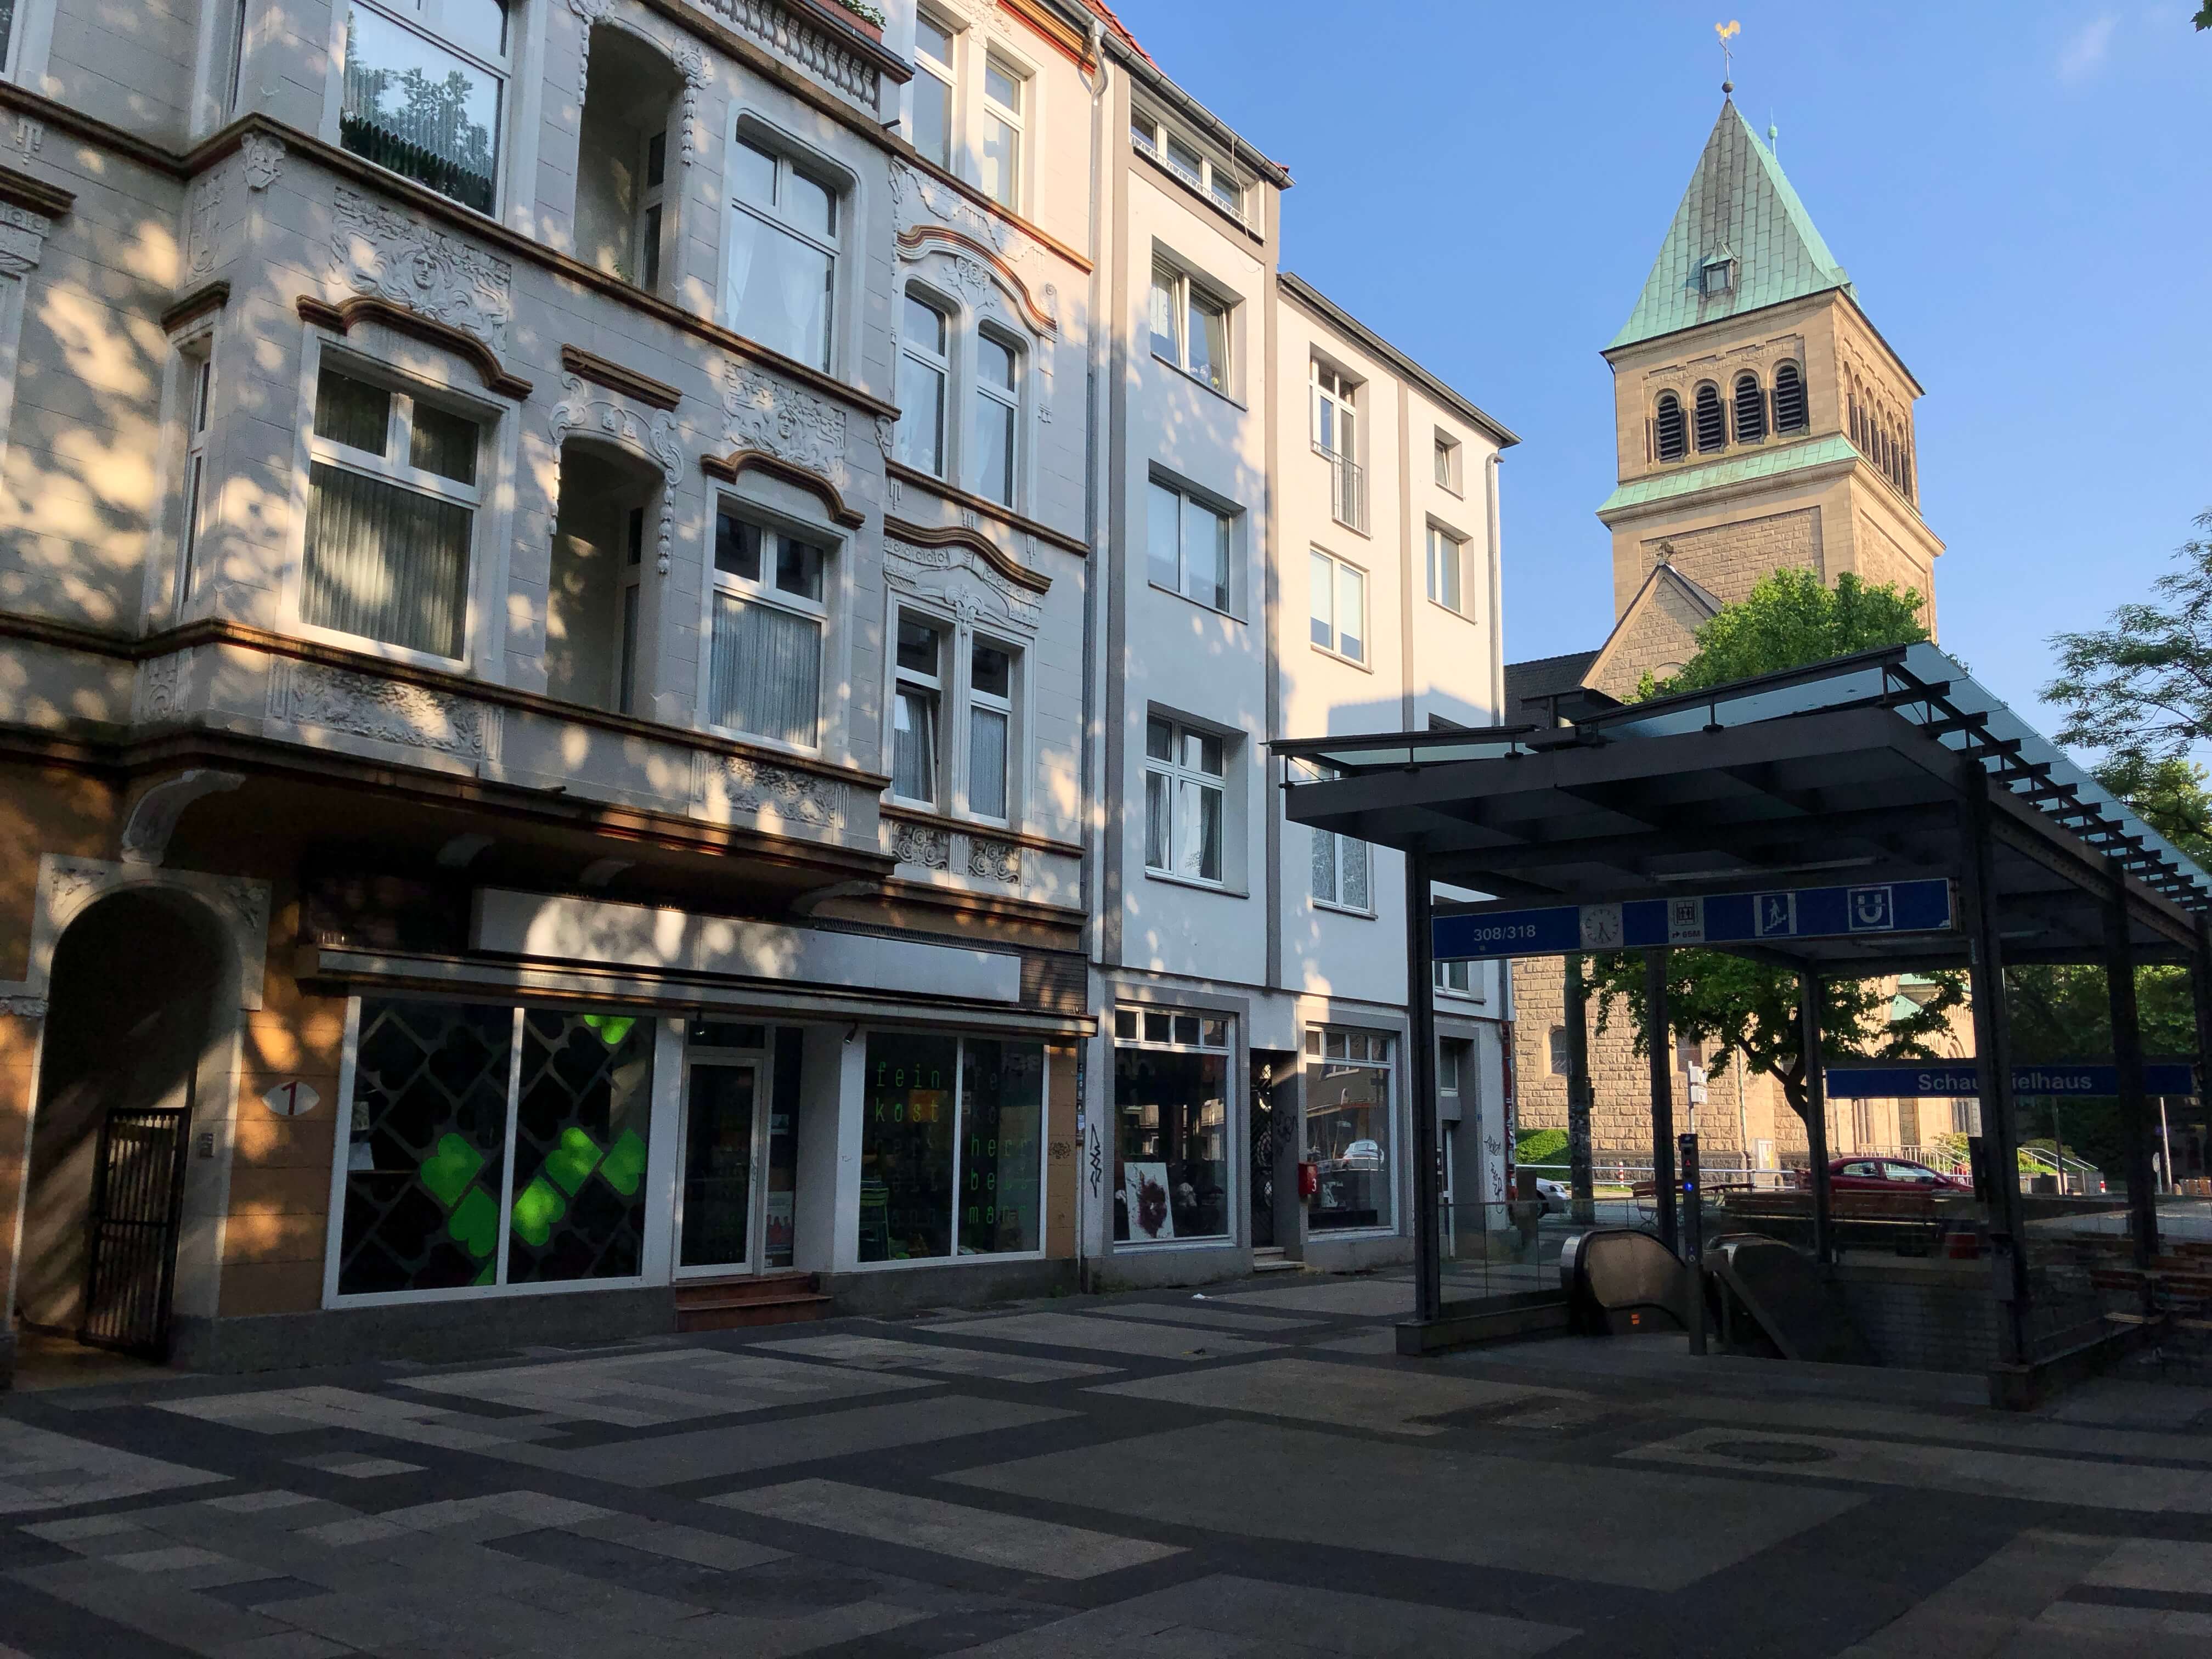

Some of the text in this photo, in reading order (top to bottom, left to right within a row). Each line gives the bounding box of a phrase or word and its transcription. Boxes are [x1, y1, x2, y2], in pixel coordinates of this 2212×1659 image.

[1473, 924, 1536, 941] 308/318
[876, 1061, 940, 1089] fein
[281, 1081, 297, 1115] 1
[874, 1097, 939, 1123] kost
[1312, 1178, 1317, 1192] 3
